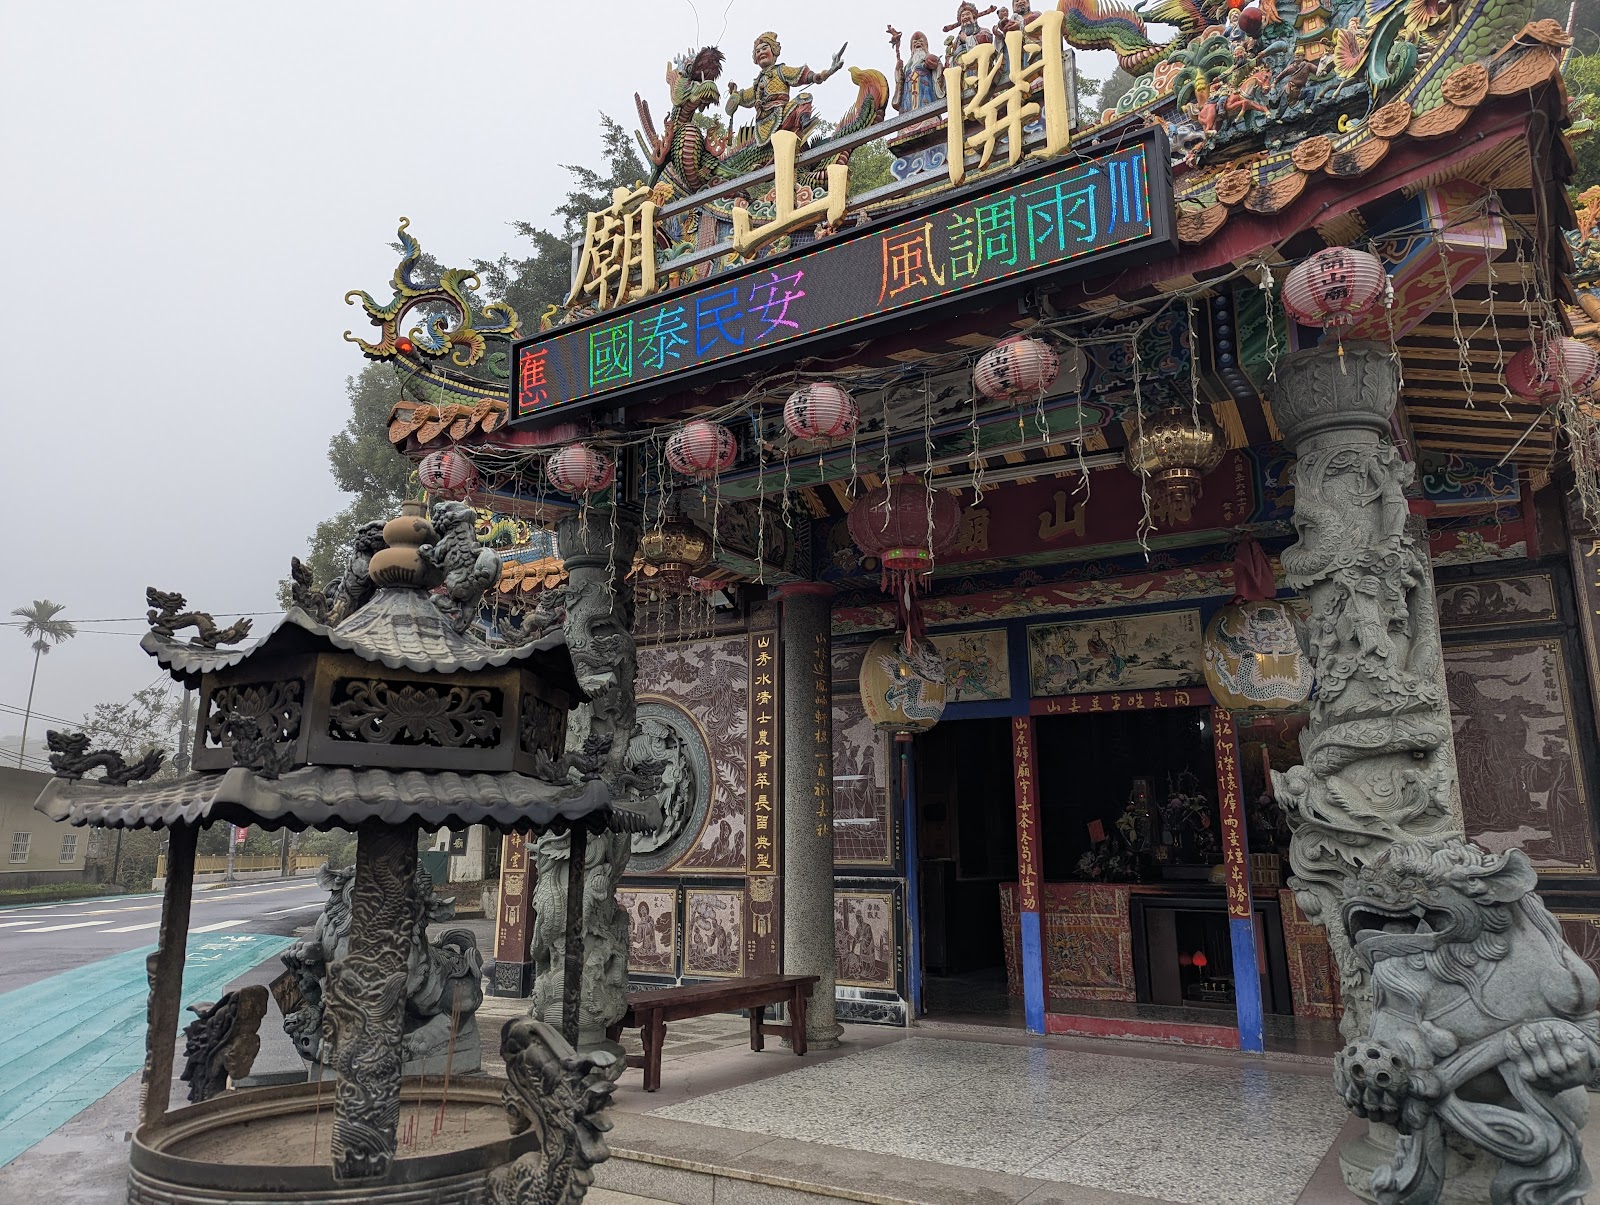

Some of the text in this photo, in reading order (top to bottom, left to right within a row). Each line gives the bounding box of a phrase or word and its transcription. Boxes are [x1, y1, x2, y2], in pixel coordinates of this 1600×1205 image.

[589, 270, 806, 388] 國泰民安
[1542, 655, 1559, 702] 天官賜福
[753, 636, 772, 869] 山秀水清士農薈萃長留典型
